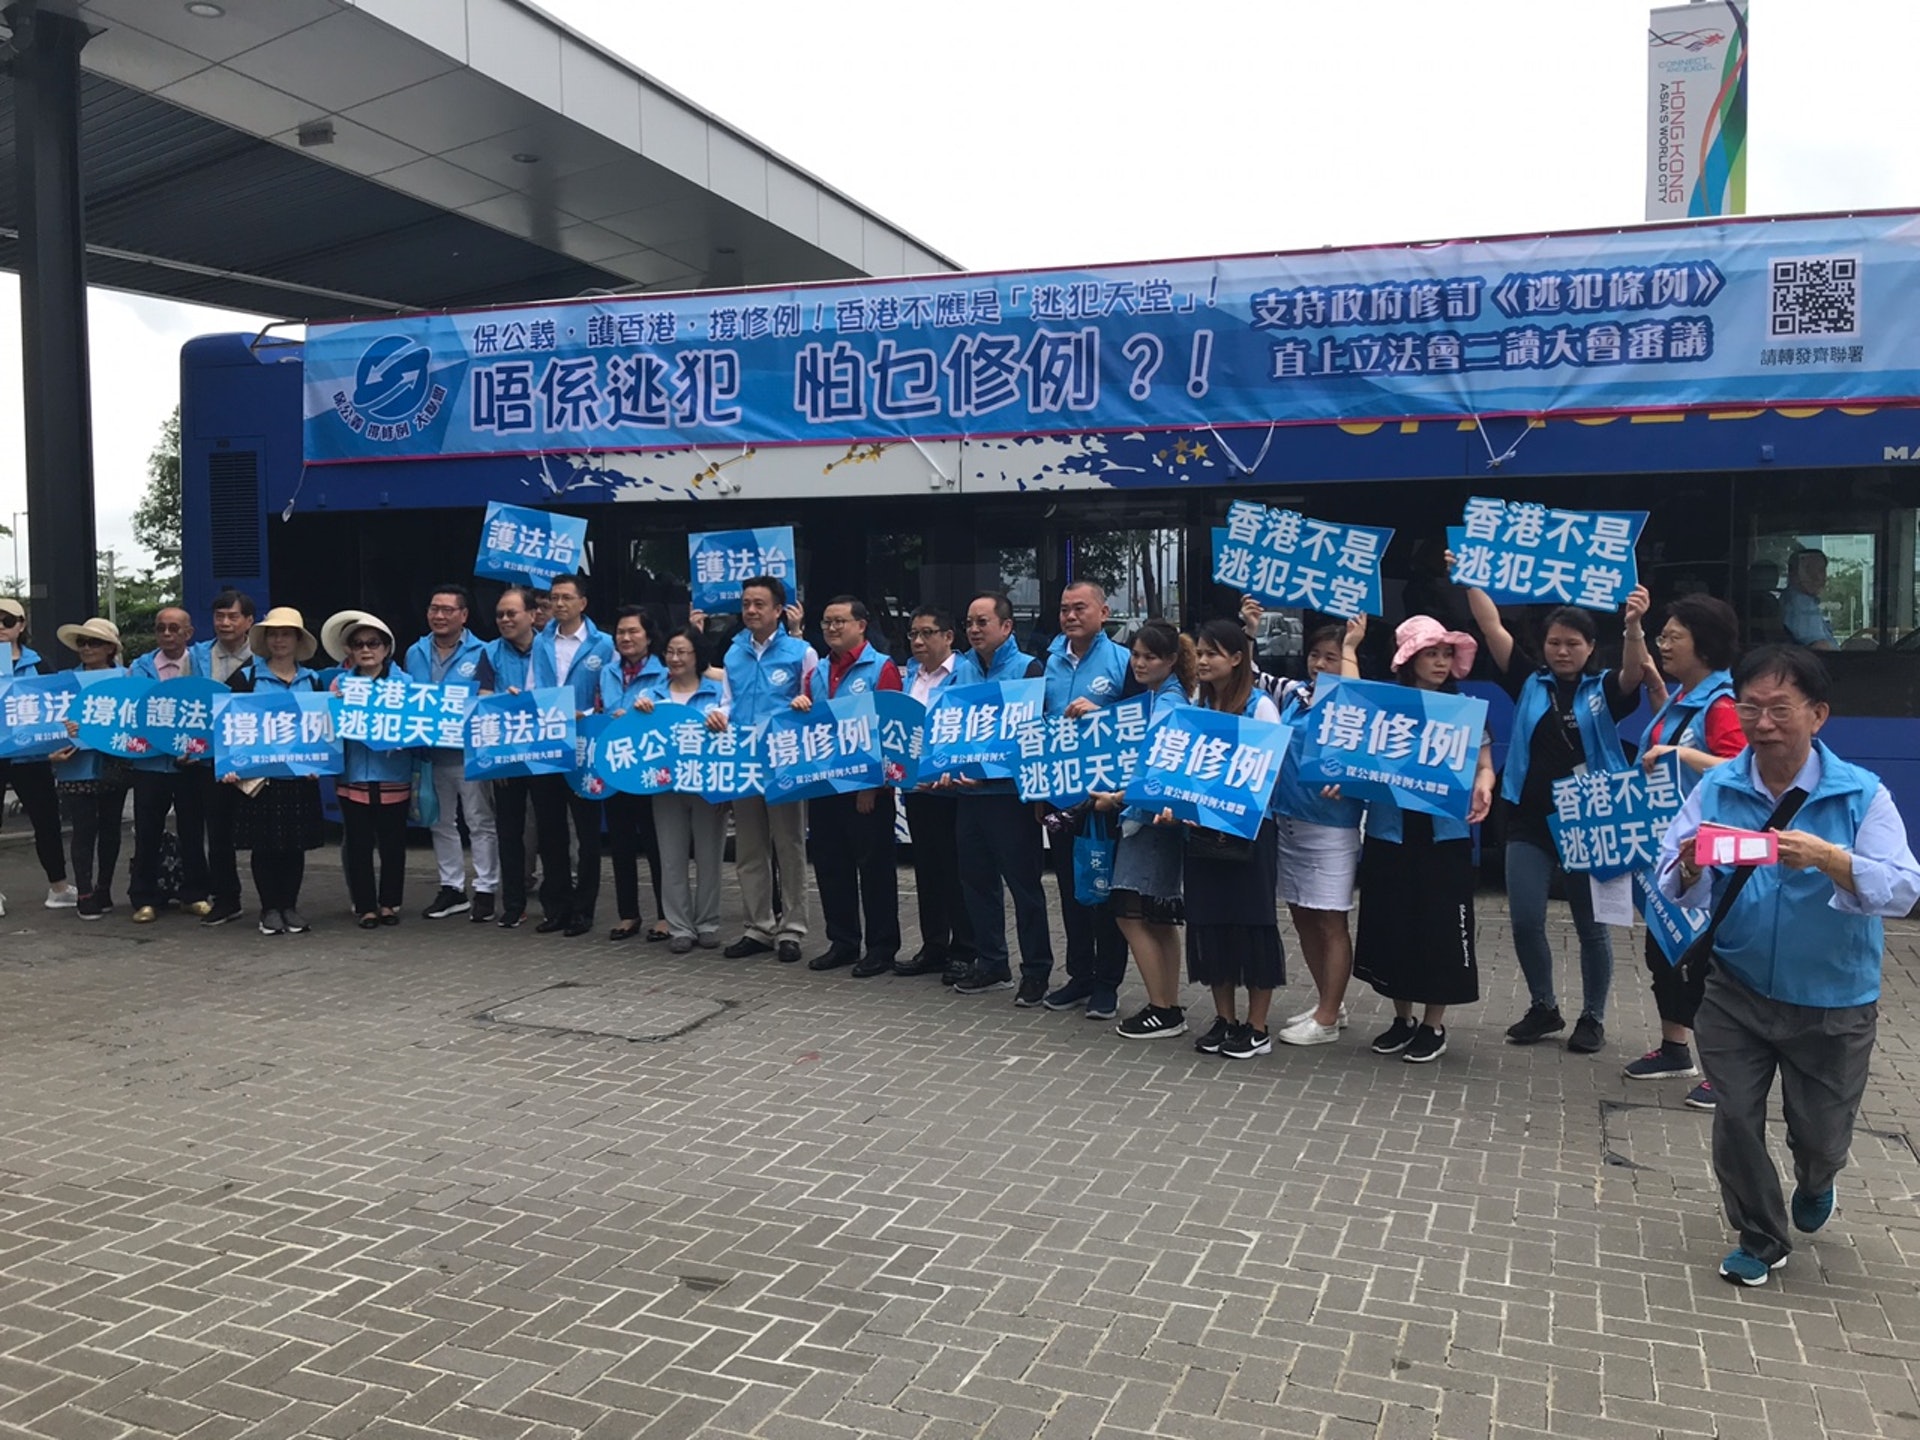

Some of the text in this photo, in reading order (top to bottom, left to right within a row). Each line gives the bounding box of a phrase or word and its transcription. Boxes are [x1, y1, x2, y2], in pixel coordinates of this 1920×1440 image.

[1657, 83, 1669, 203] ASIA'S WORLD CITY
[1669, 80, 1685, 203] HONG KONG
[1272, 320, 1712, 379] 直上立法會二讀大會審議
[1760, 345, 1864, 367] 請轉發齊聯署
[471, 349, 743, 434] 唔係逃犯
[487, 519, 576, 565] 護法治
[1228, 500, 1378, 576] 香港不是
[1464, 497, 1631, 563] 香港不是
[696, 546, 787, 583] 護法治
[1215, 544, 1368, 618] 逃犯天堂
[1450, 543, 1621, 613] 逃犯天堂
[147, 697, 215, 730] 護法
[342, 677, 469, 715] 香港不是
[223, 711, 335, 746] 撐修例
[336, 709, 465, 748] 逃犯天堂
[471, 706, 567, 748] 護法治
[605, 721, 681, 773] 保公
[767, 715, 872, 769] 撐修例
[1018, 702, 1147, 759] 香港不是
[1316, 701, 1470, 772] 撐修例
[674, 760, 765, 793] 逃犯天
[1145, 726, 1273, 793] 撐修例
[1553, 762, 1678, 823] 香港不是
